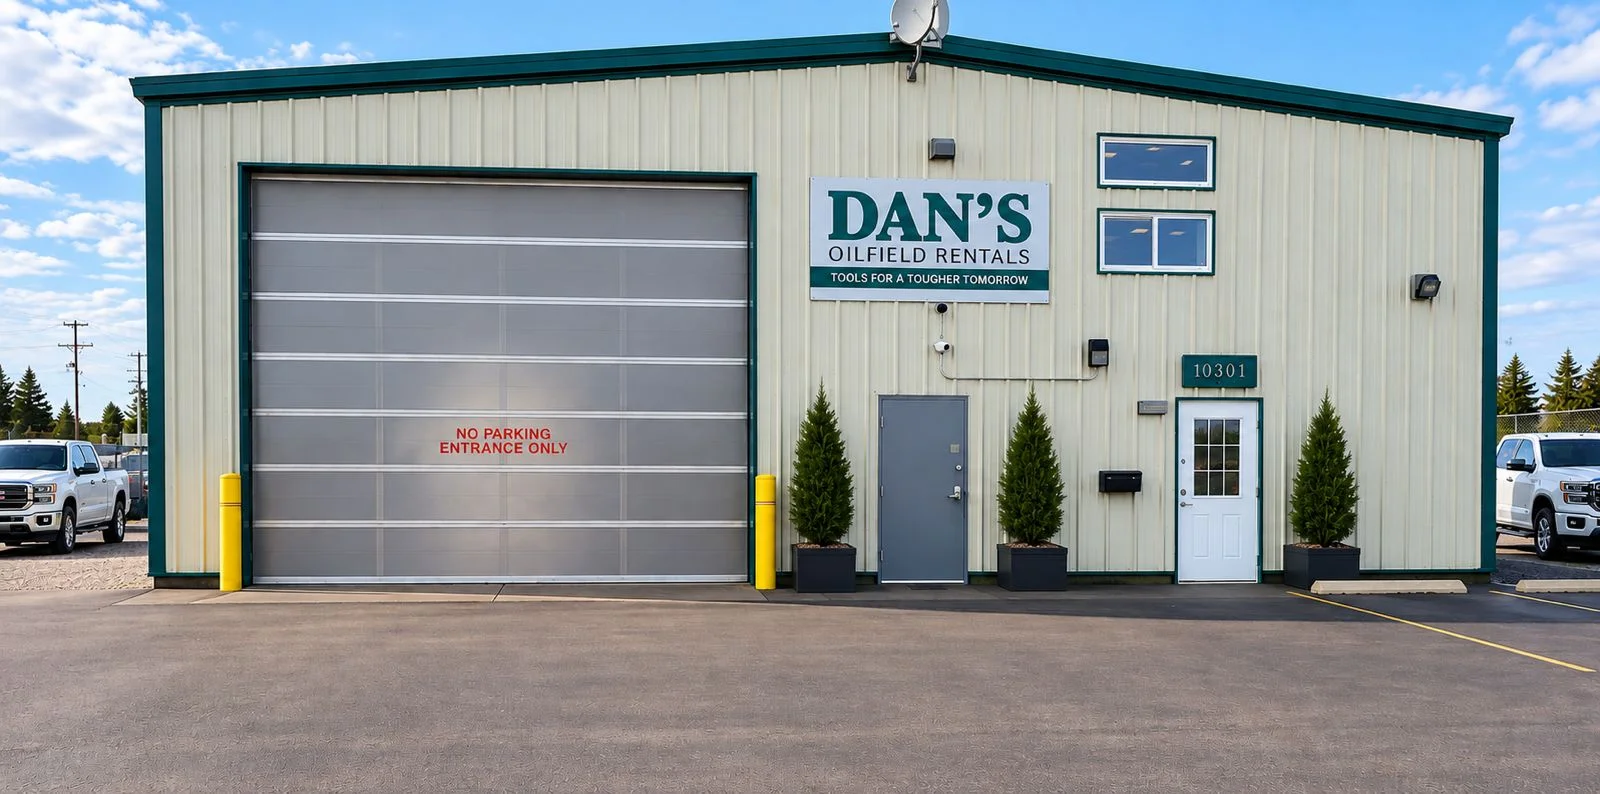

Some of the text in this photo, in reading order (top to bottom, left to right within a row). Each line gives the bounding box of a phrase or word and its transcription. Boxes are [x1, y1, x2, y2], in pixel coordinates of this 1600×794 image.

[828, 190, 1032, 243] DAN'S
[829, 246, 1030, 264] OILFIELD RENTALS
[831, 272, 1028, 285] TOOLS FOR A TOUGHER TOMORROW
[1194, 363, 1246, 378] 10301
[456, 428, 551, 440] NO PARKING
[440, 442, 568, 454] ENTRANCE ONLY
